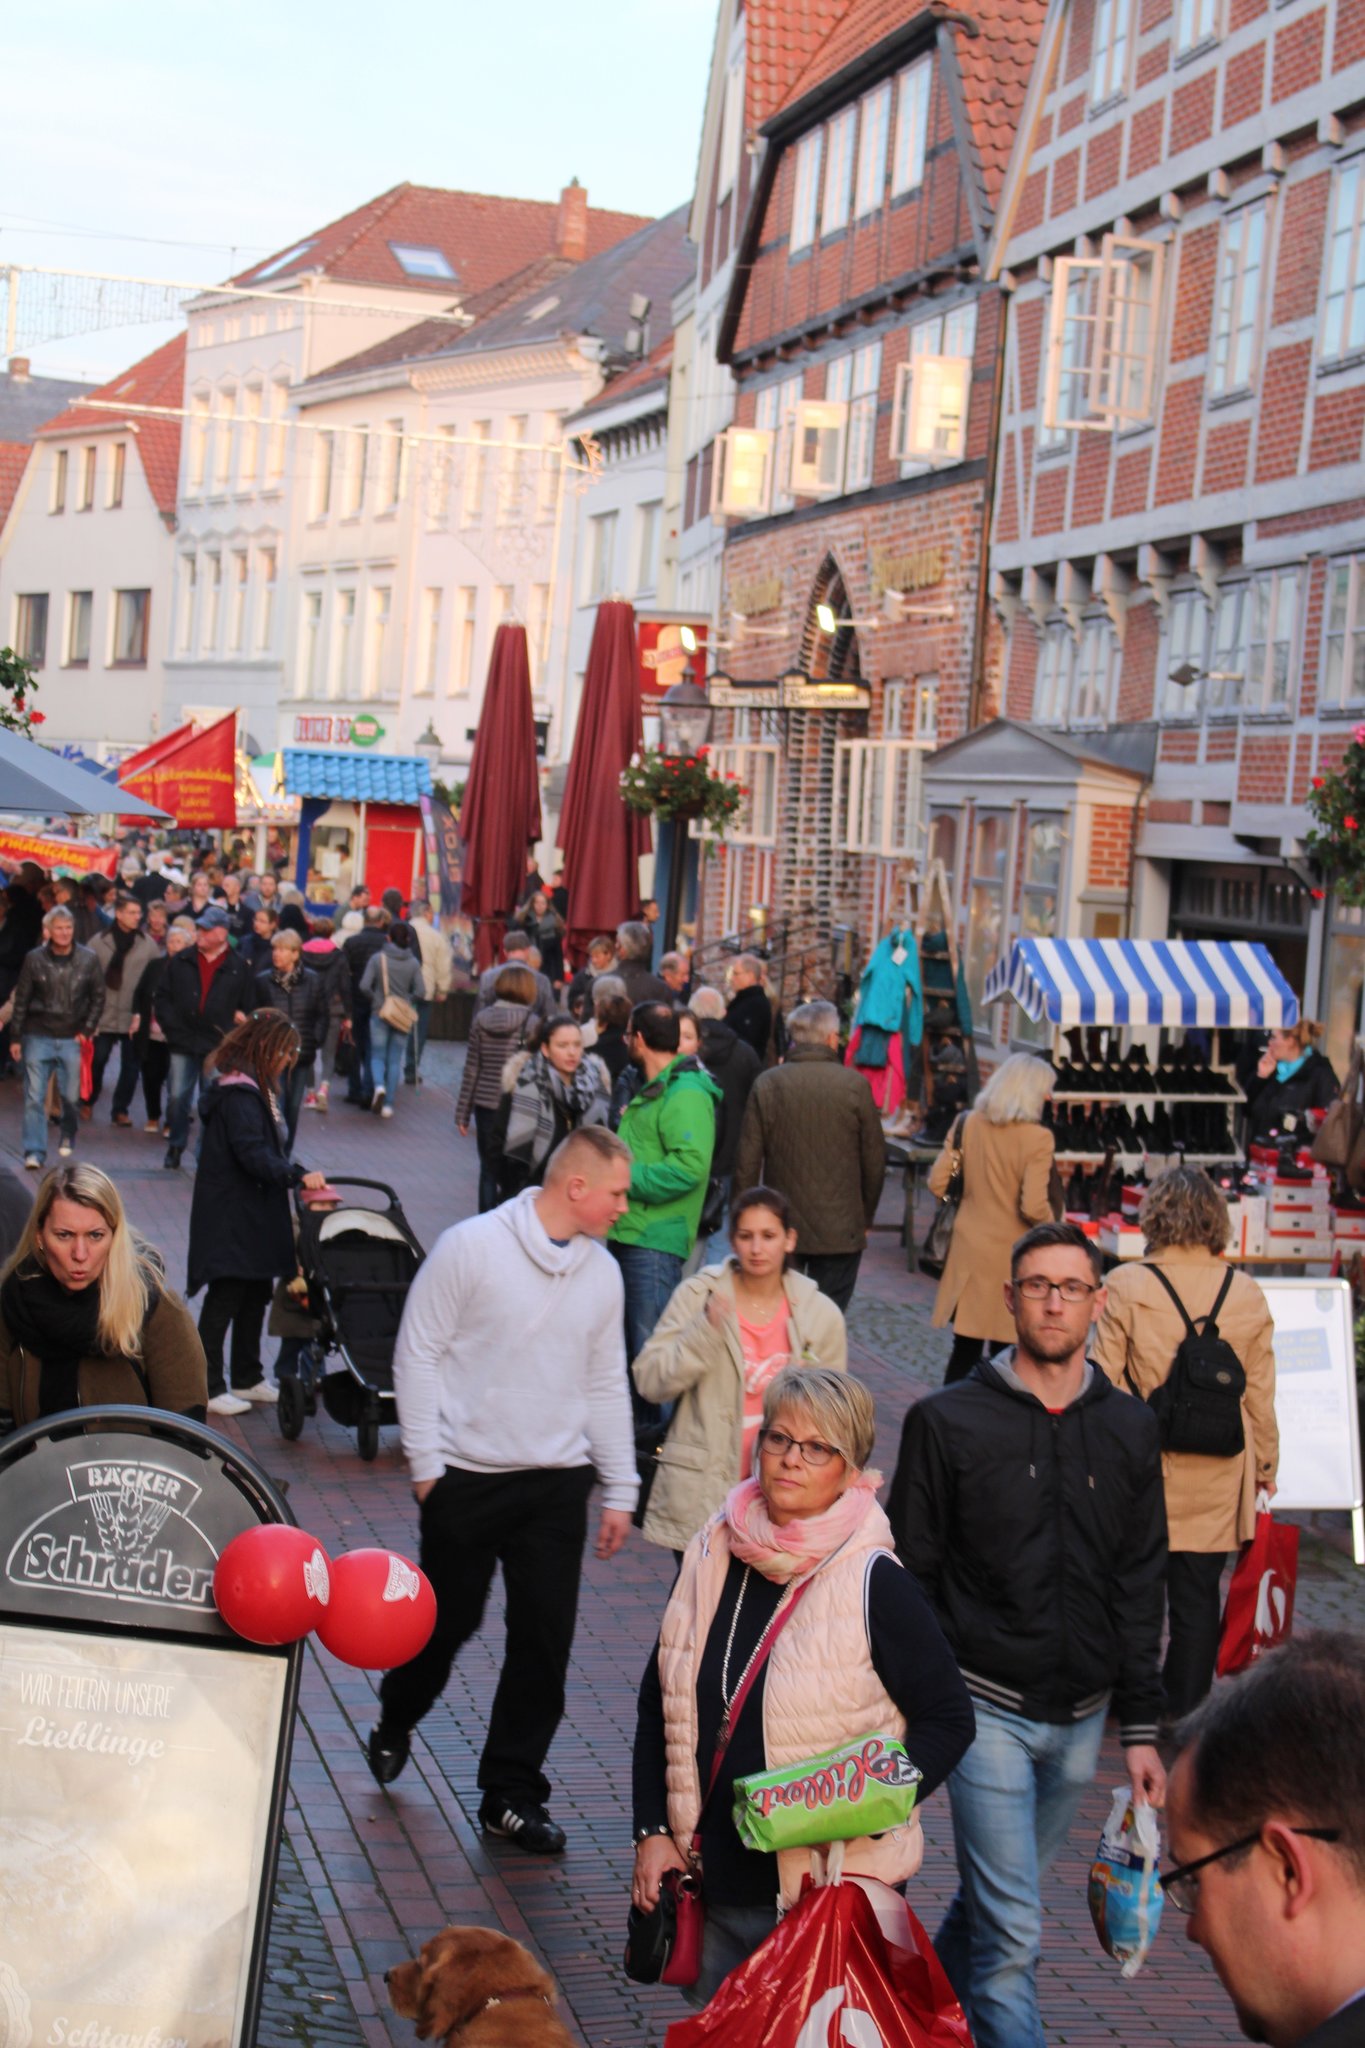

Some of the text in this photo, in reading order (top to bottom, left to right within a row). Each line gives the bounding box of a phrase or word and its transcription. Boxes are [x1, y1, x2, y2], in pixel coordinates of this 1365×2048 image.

[87, 1467, 182, 1500] BÄCKER
[24, 1532, 214, 1603] Schrader
[20, 1671, 175, 1719] WIR FEIERN UNSERE
[17, 1715, 166, 1767] Lieblinge
